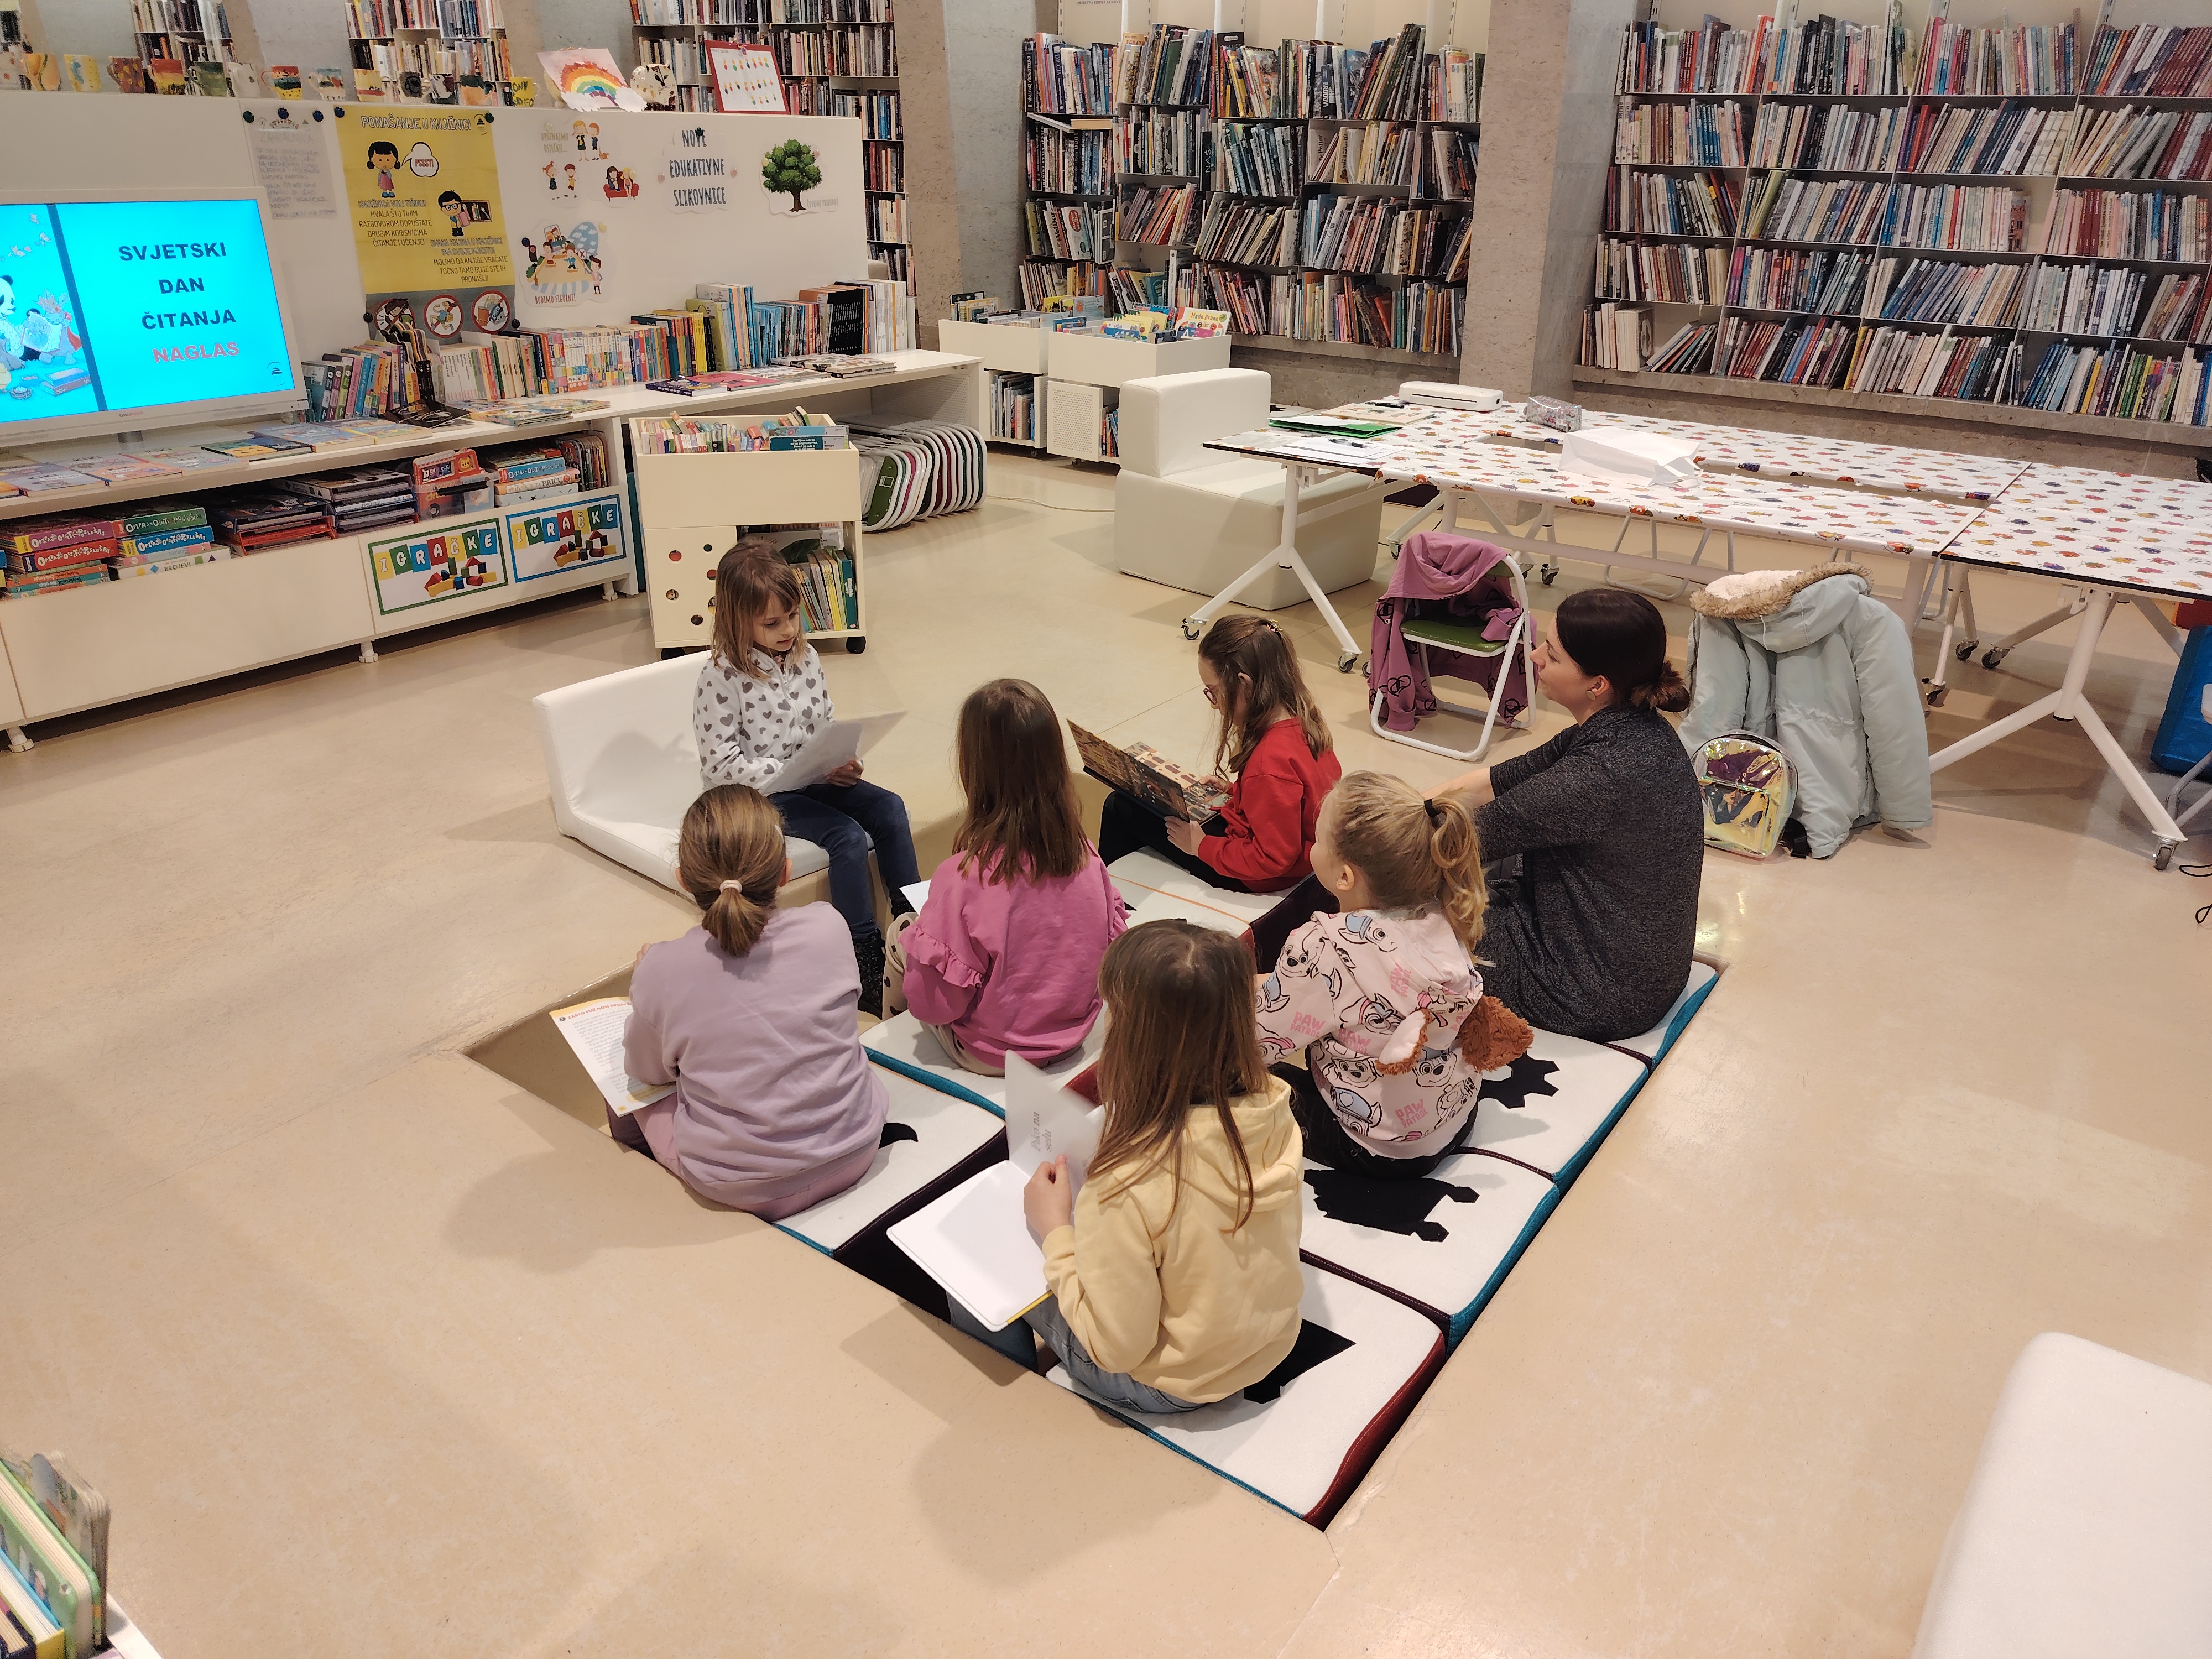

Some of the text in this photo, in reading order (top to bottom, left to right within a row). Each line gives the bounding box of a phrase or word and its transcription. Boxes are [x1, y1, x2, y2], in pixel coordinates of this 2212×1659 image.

[361, 113, 471, 131] PONAŠANJE U KNJIŽNICI
[682, 129, 707, 148] NOVE
[669, 158, 726, 178] EDUKATIVNE
[673, 186, 727, 207] SLIKOVNICE
[390, 208, 402, 217] ŠTO
[359, 218, 432, 228] RAZGOVOROM DOPUŠTATE
[368, 228, 428, 238] DRUGIM KORISNICIMA
[118, 242, 227, 262] SVJETSKI
[373, 238, 397, 247] ČITANJE
[401, 237, 425, 246] UČENJE!
[440, 265, 458, 274] TOČNO
[484, 255, 508, 264] VRAĆATE
[159, 277, 205, 294] DAN
[535, 293, 576, 304] BUDIMO SIGURNI!
[142, 309, 237, 330] ČITANJA
[152, 341, 240, 363] NAGLAS
[541, 476, 562, 487] PRIČU
[516, 508, 614, 544] IGRAČKE
[380, 534, 492, 573] IGRAČKE
[164, 561, 191, 572] BROJEVI
[1389, 961, 1405, 994] PAW
[1400, 967, 1412, 998] PATROL
[567, 1011, 586, 1020] ZAŠTO
[585, 1006, 596, 1014] PUŽ
[1292, 1011, 1326, 1032] PAW
[1290, 1022, 1321, 1039] PATROL
[1339, 1027, 1371, 1047] PAW
[1394, 1098, 1425, 1122] PAW
[1400, 1107, 1429, 1129] PATROL
[1031, 1111, 1041, 1153] Piko na
[1042, 1129, 1052, 1152] selu
